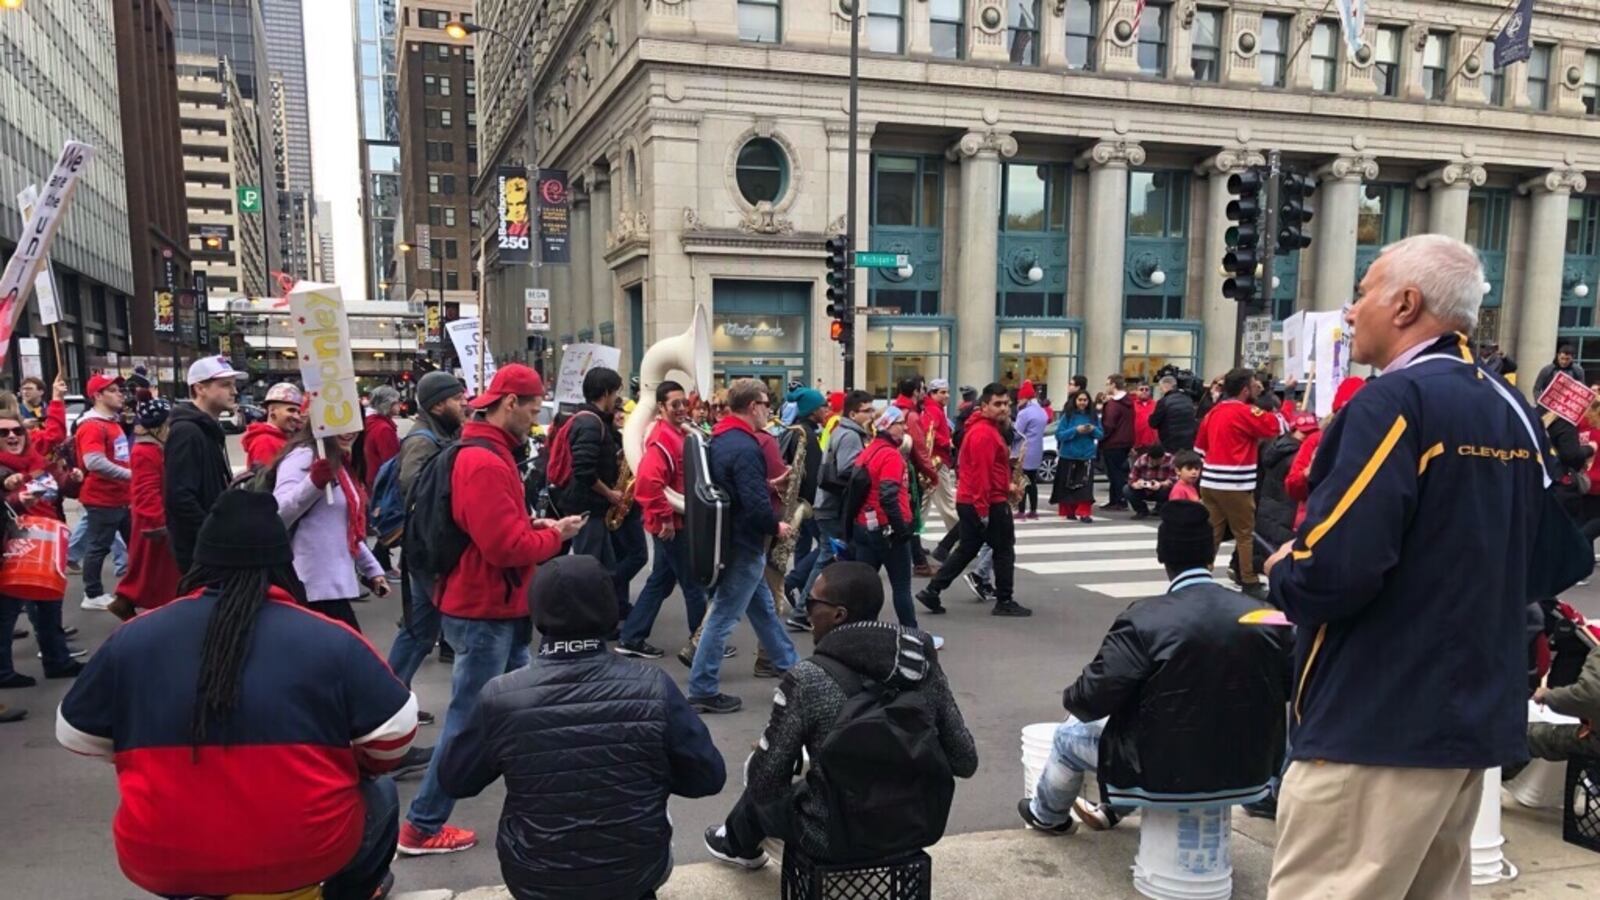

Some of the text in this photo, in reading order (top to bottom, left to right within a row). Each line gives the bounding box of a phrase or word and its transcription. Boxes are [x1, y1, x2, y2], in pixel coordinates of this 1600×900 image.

[60, 148, 84, 173] We
[498, 236, 529, 249] 250
[196, 276, 208, 345] OPUS
